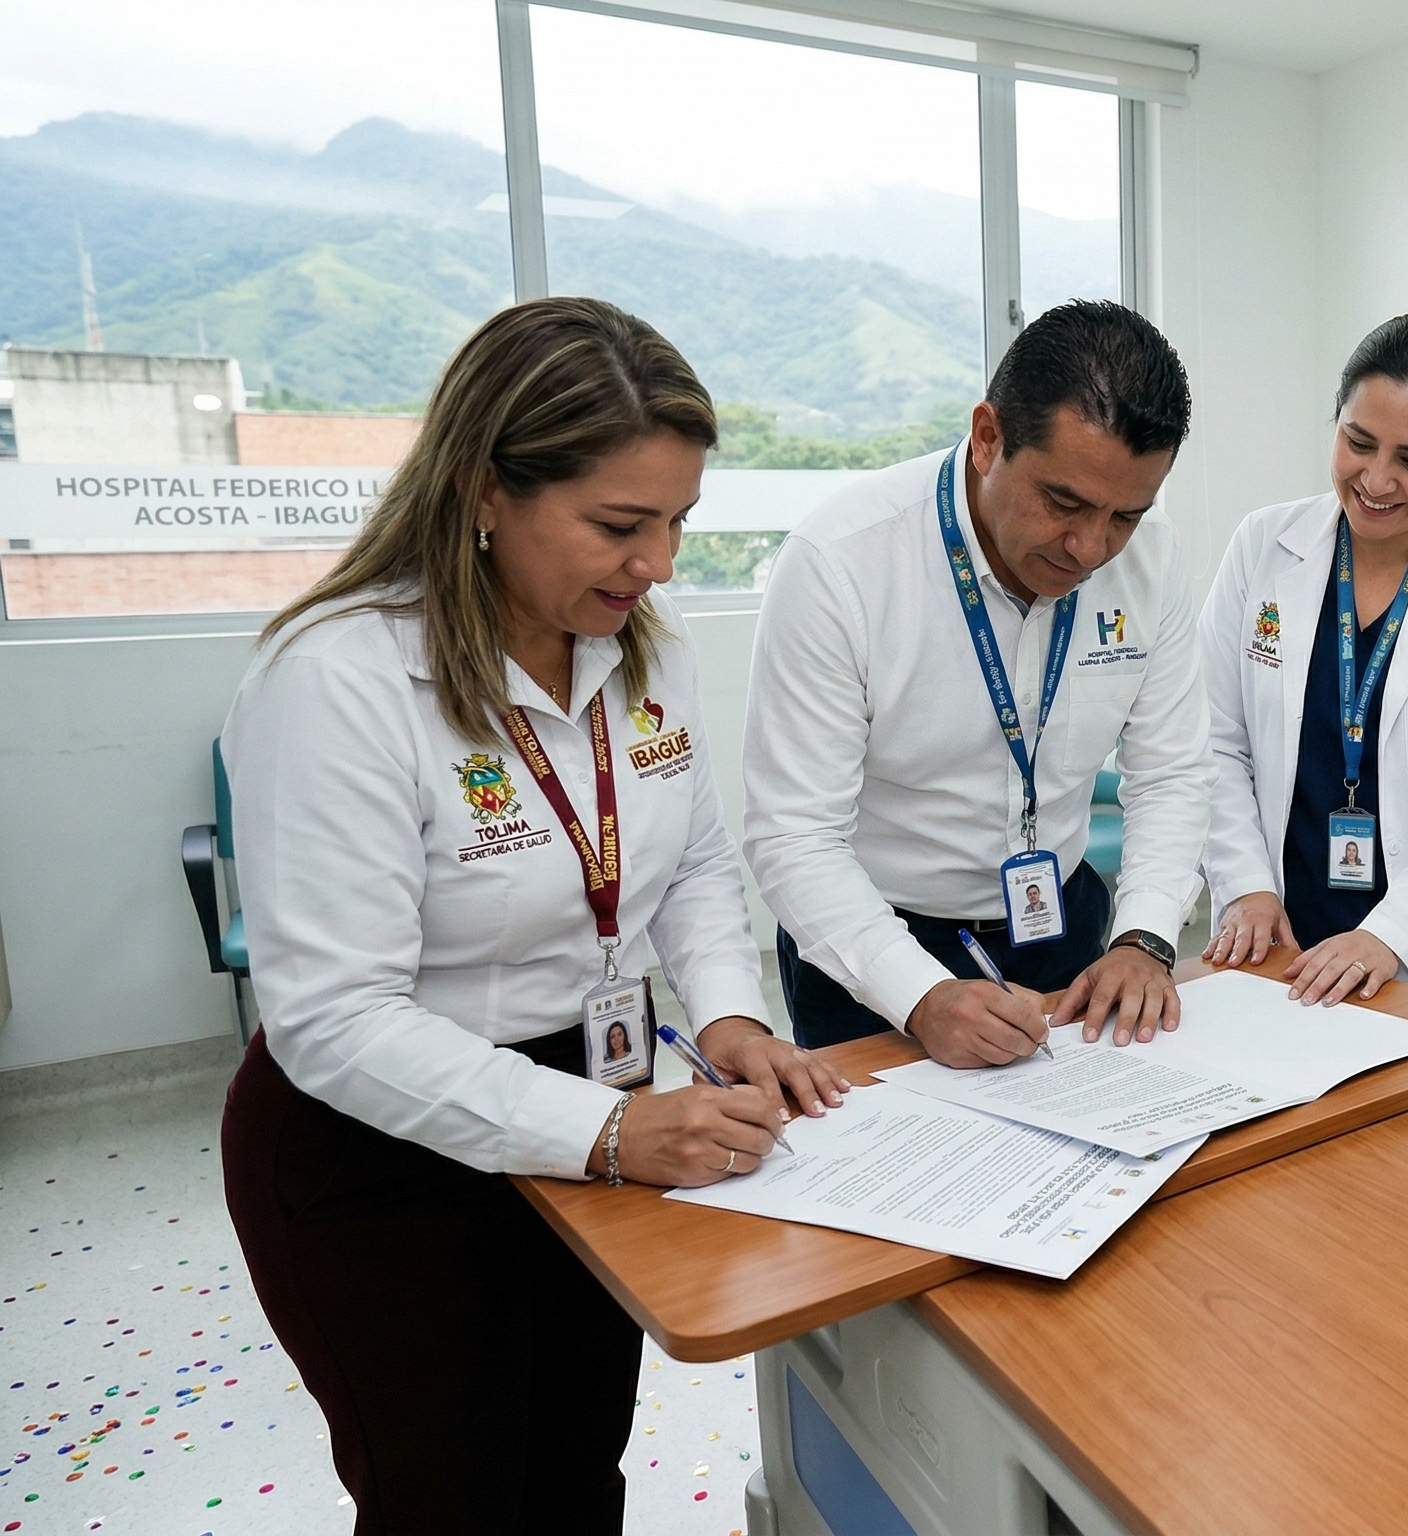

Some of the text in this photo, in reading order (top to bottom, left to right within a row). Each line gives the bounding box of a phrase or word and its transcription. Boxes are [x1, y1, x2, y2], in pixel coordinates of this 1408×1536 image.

[56, 477, 205, 498] HOSPITAL
[213, 478, 349, 498] FEDERICO
[134, 506, 250, 526] ACOSTA
[275, 505, 362, 525] IBAGU
[629, 727, 691, 770] IBAGUÉ
[475, 819, 531, 842] TOLIMA
